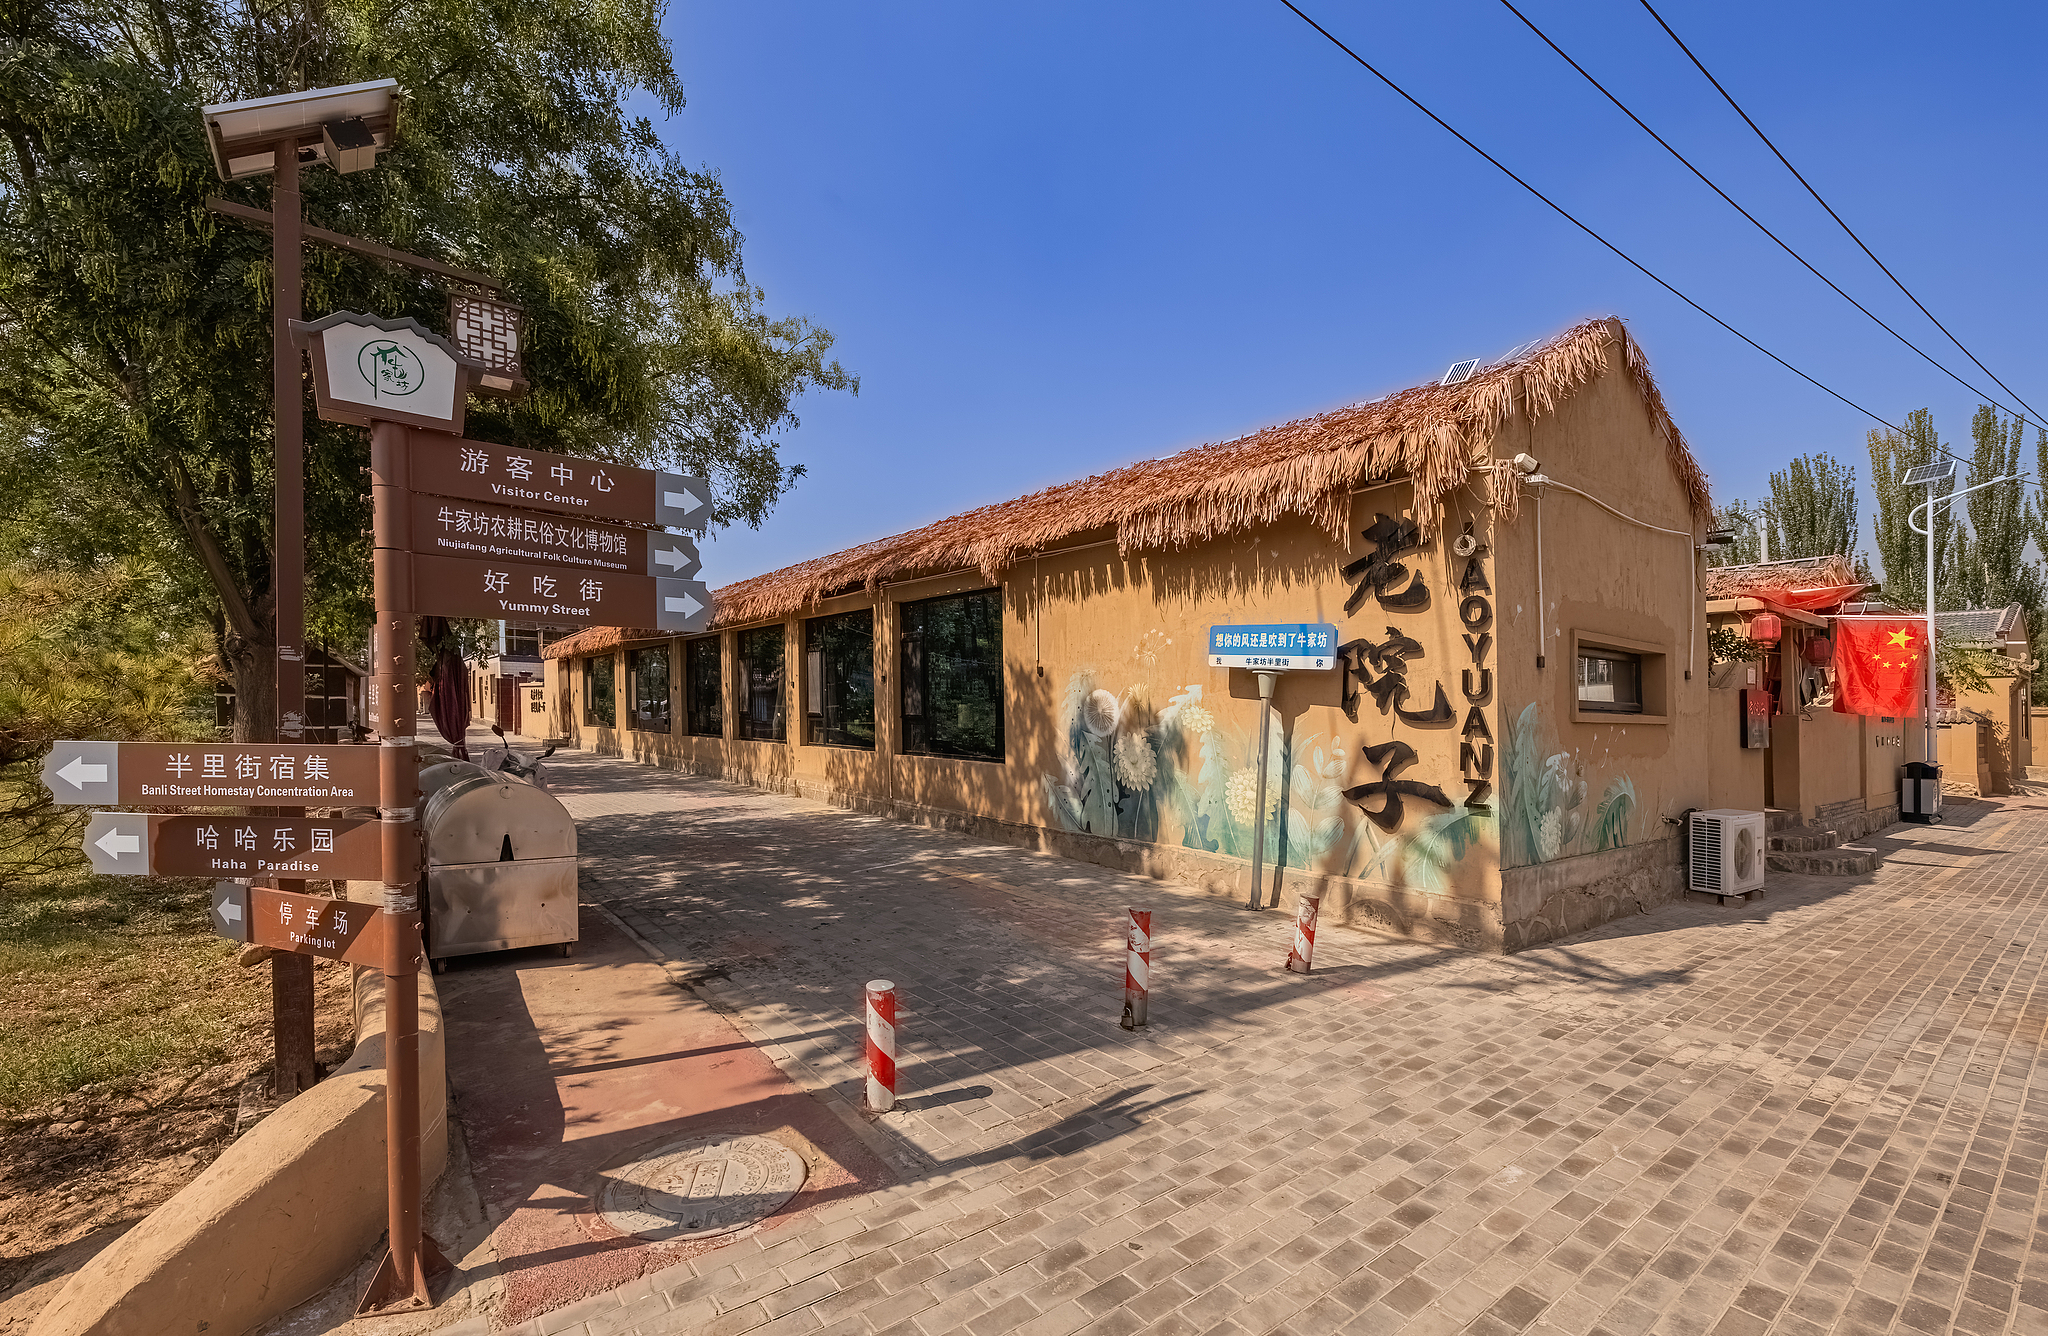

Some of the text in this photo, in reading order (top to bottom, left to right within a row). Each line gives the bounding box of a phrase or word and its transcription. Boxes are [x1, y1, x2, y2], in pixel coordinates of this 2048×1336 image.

[460, 447, 615, 493] 游客中心
[491, 483, 589, 507] Visitor Center
[437, 506, 628, 556] 牛家坊农耕民俗文化博物馆
[437, 538, 628, 571] Niujiafang Agricultural Folk Culture Museum
[483, 569, 604, 602] 好吃街
[499, 600, 591, 617] Yummy Street
[1215, 632, 1328, 648] 想你的风还是吹到了牛家坊
[1337, 513, 1456, 830] 老院子
[165, 752, 331, 781] 半里街宿集
[141, 784, 354, 799] Banli Street Homestay Concentration Area
[196, 825, 335, 854] 哈哈乐园
[211, 858, 320, 872] Haha Paradise
[279, 901, 349, 936] 停车场
[290, 931, 336, 950] Parking lot
